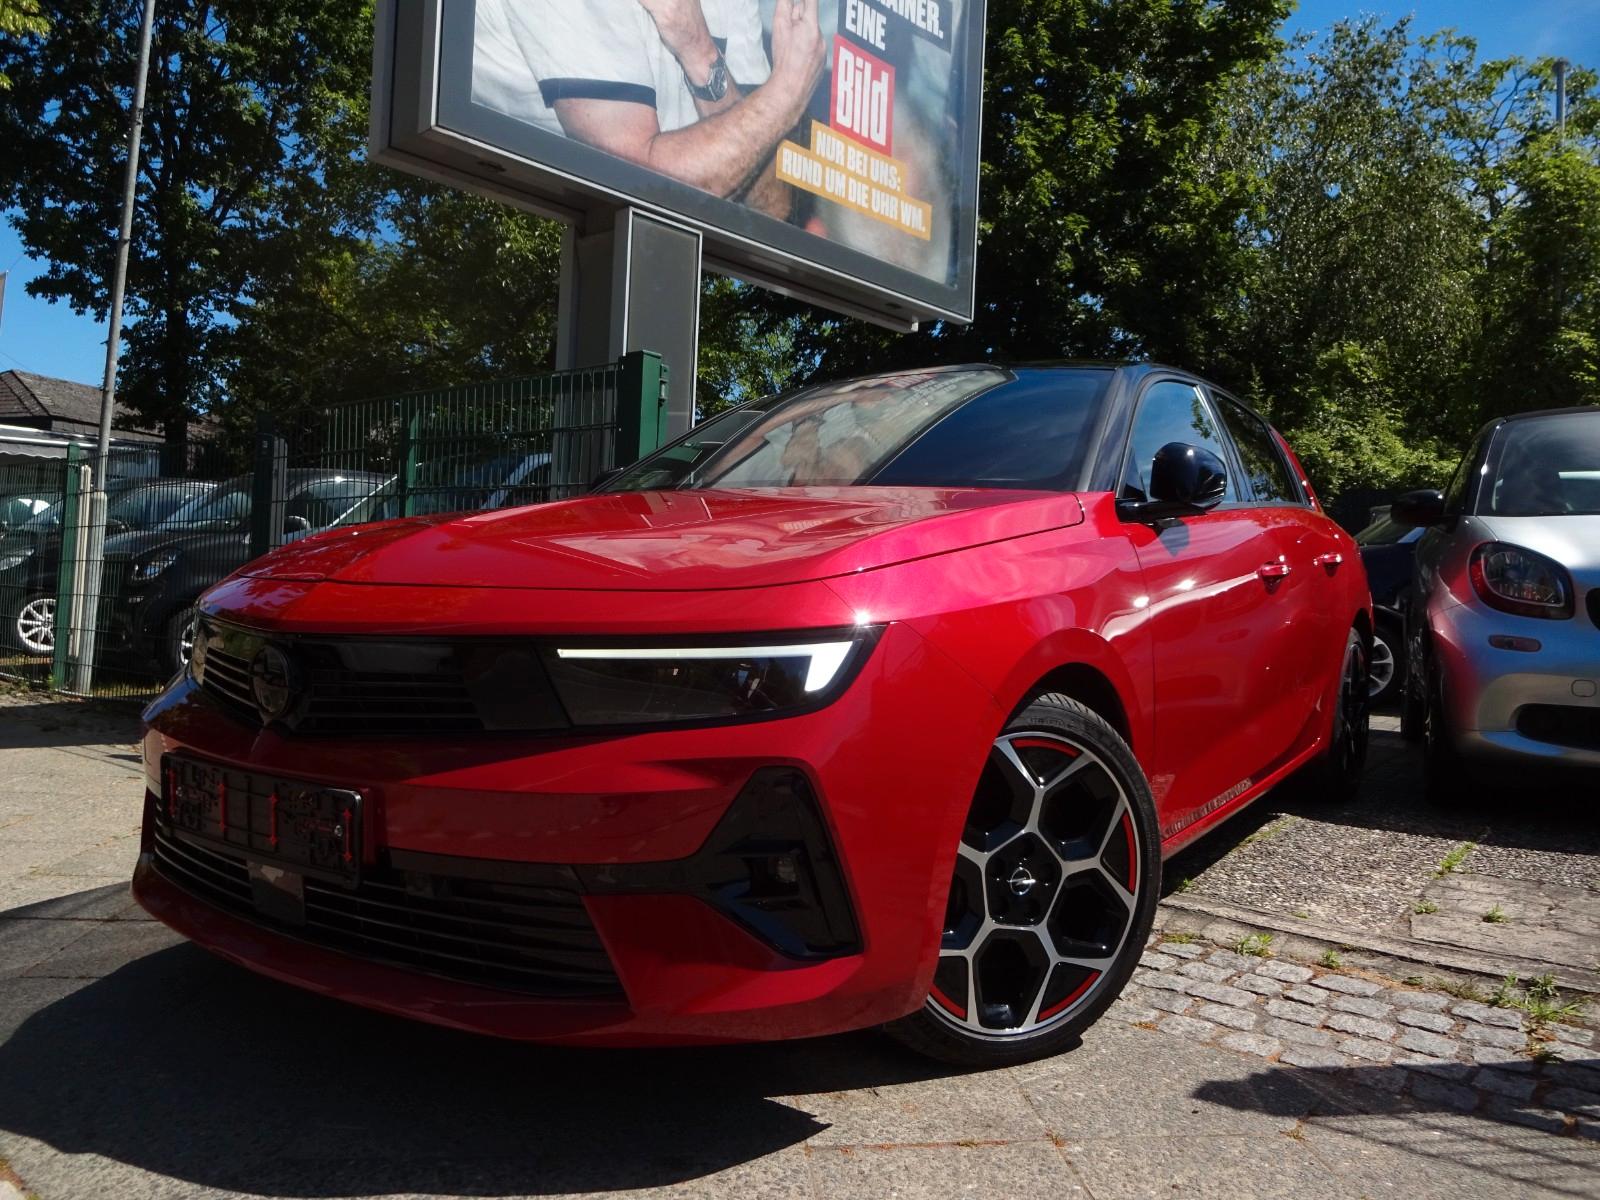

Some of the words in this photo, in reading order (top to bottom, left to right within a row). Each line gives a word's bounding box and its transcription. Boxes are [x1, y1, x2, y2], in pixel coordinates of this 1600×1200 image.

[845, 0, 886, 51] EINE
[836, 46, 889, 147] Bild
[782, 147, 823, 188] RUND
[825, 166, 847, 199] UM
[848, 177, 869, 209] DIE
[871, 188, 898, 221] UHR
[900, 200, 926, 233] WM.
[815, 130, 845, 167] NUR
[847, 144, 869, 178] BEI
[870, 155, 901, 192] UNS:
